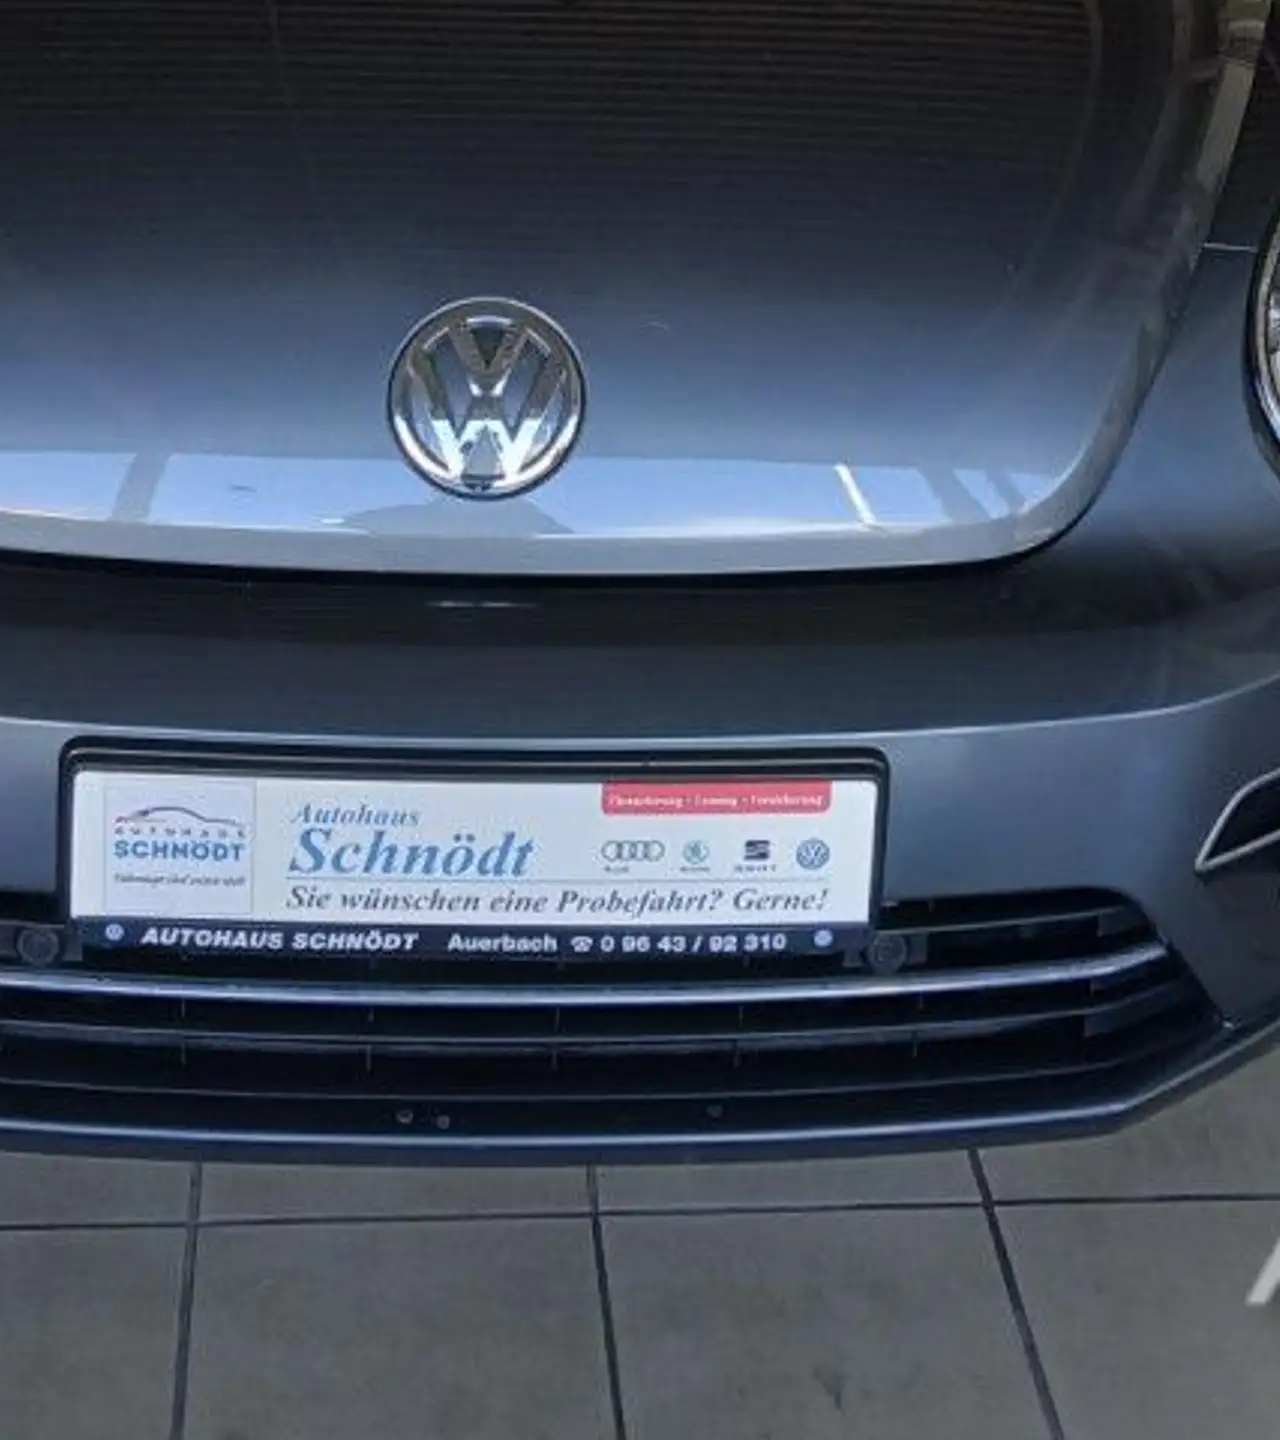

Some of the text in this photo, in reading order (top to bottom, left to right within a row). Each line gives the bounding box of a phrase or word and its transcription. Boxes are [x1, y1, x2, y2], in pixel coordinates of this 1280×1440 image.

[291, 802, 420, 826] Autohaus
[114, 838, 246, 861] SCHNÖDT
[288, 826, 536, 877] Schnödt
[285, 885, 829, 917] Sie wünschen eine Probefahrt? Gerne!
[140, 926, 283, 950] AUTOHAUS
[291, 929, 419, 952] SCHNÖDT
[447, 933, 558, 953] Auerbach
[600, 934, 615, 953] 0
[657, 934, 687, 953] 43
[743, 932, 788, 952] 310
